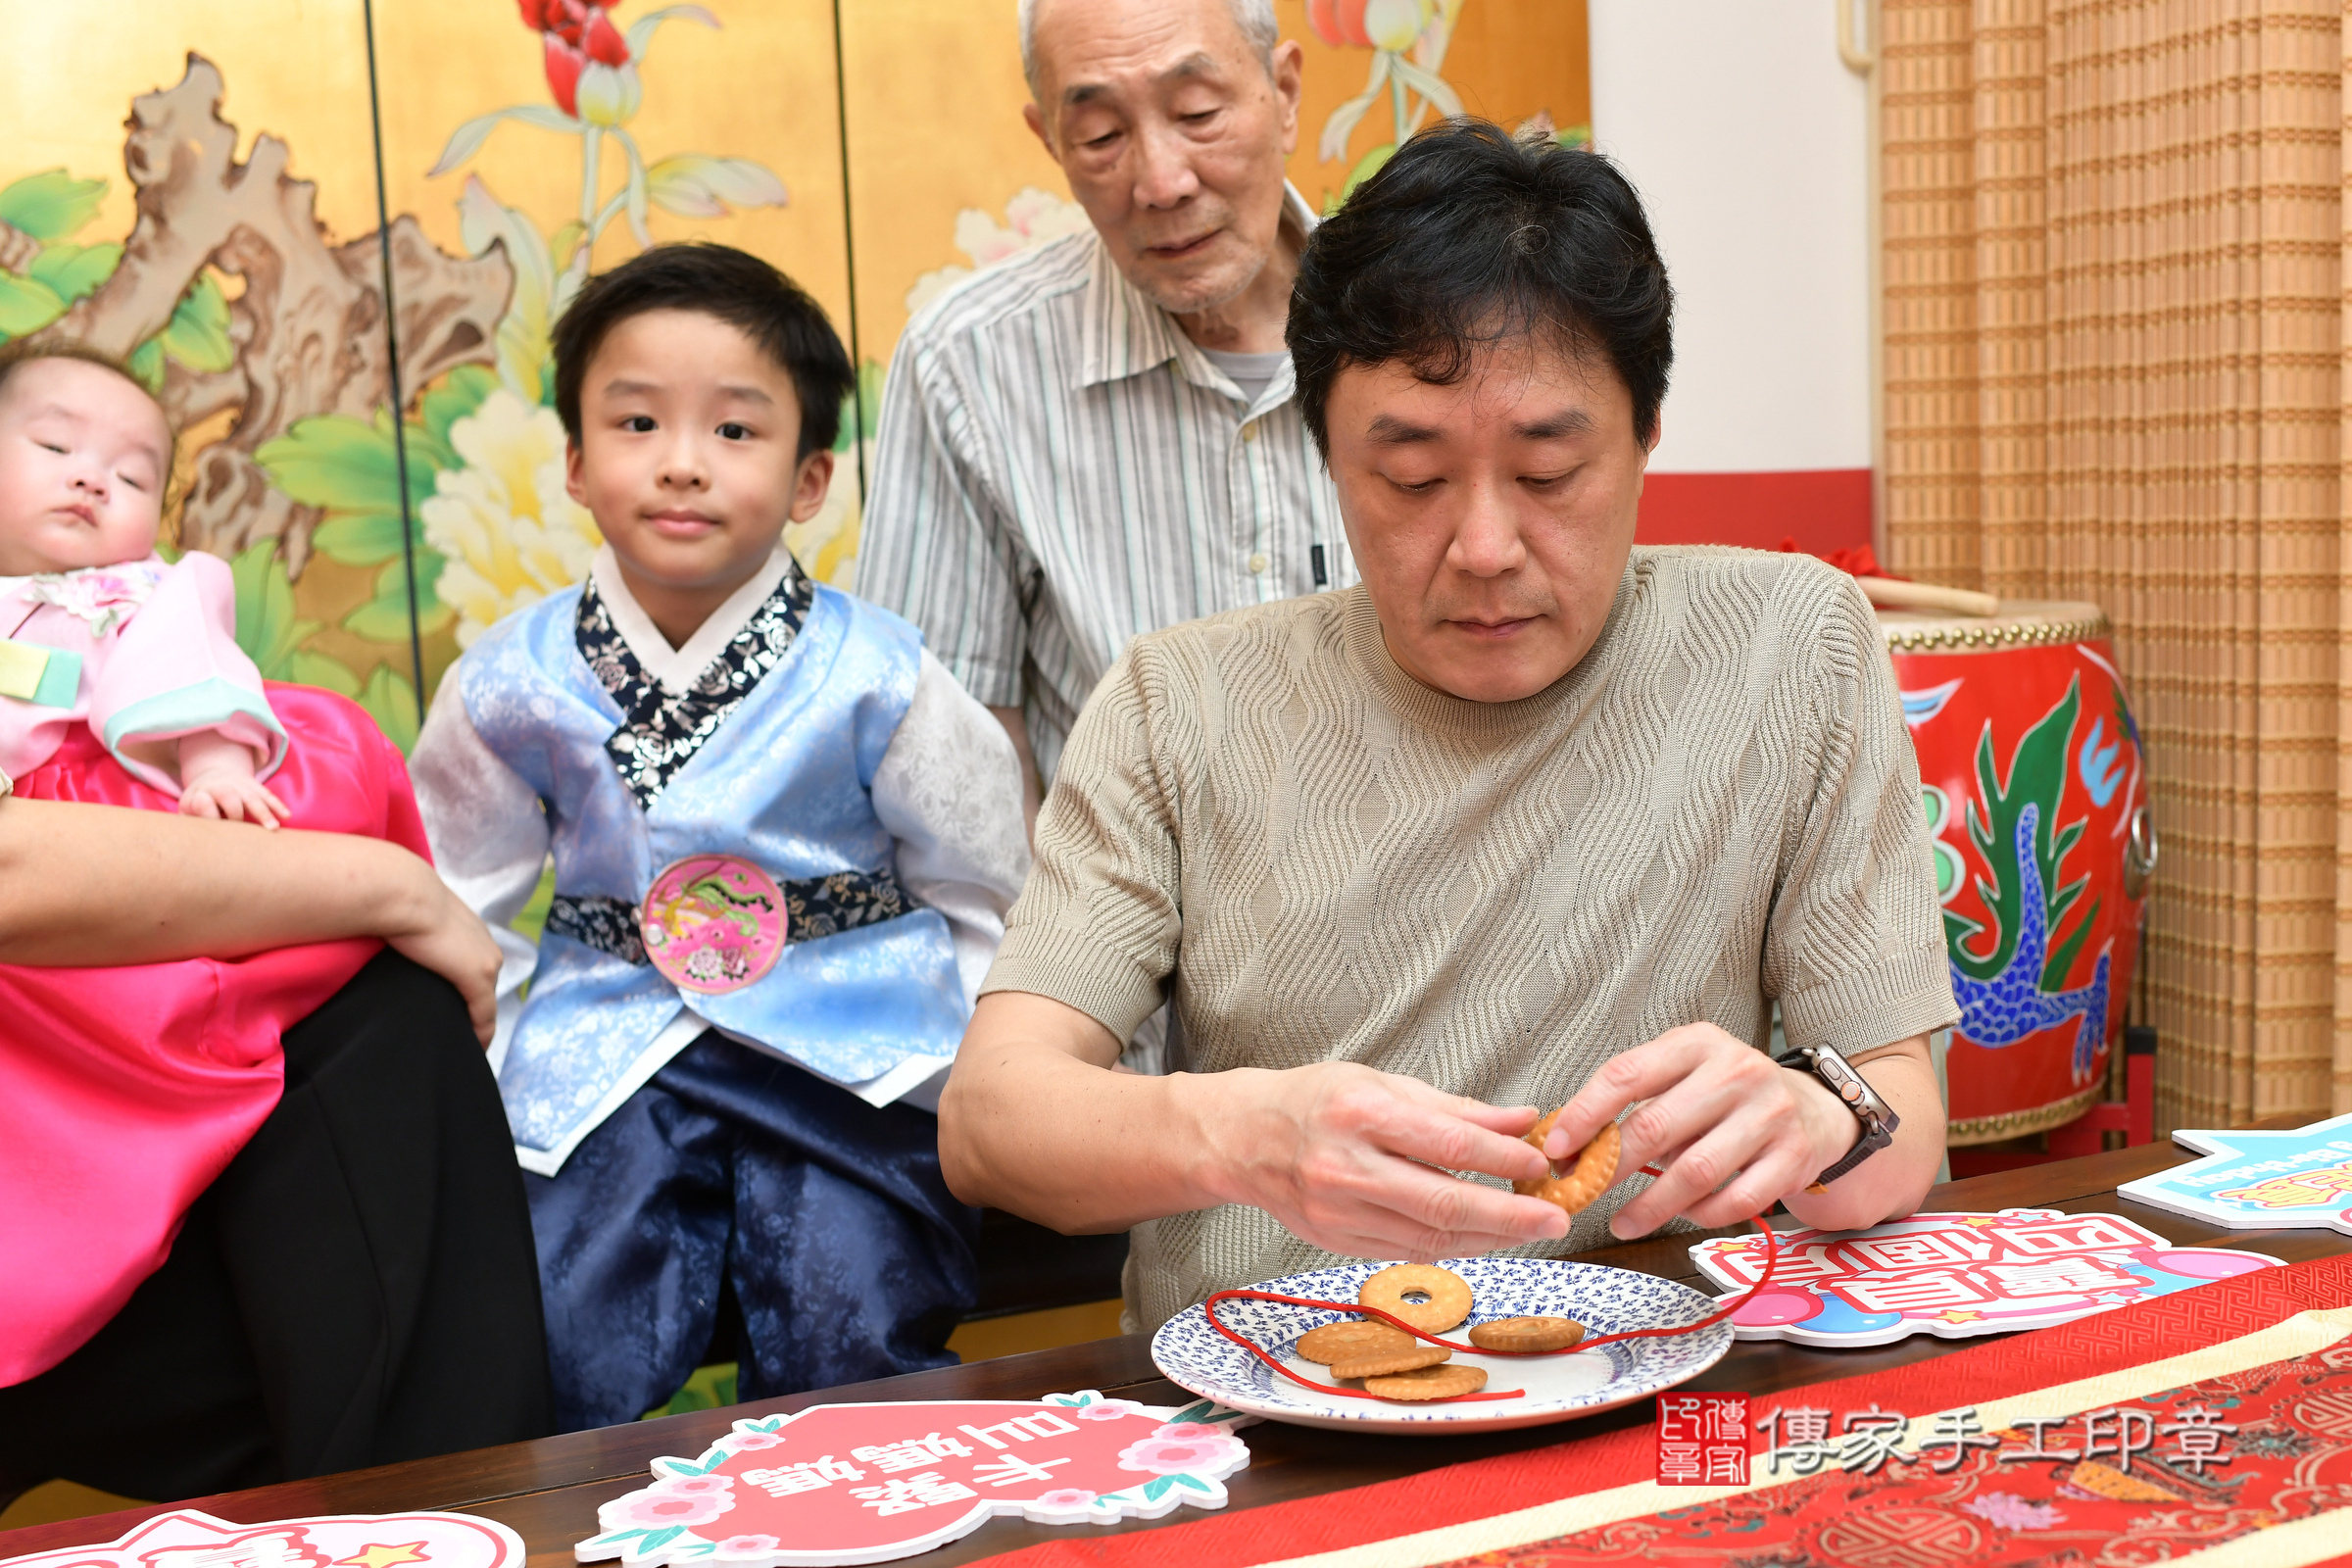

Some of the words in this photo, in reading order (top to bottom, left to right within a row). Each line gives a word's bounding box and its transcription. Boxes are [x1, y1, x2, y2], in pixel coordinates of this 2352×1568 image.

[1731, 1221, 2115, 1284] 四個月
[1842, 1256, 2140, 1311] 寶貝
[740, 1410, 1080, 1498] 叫媽媽
[848, 1454, 1071, 1517] 卡緊
